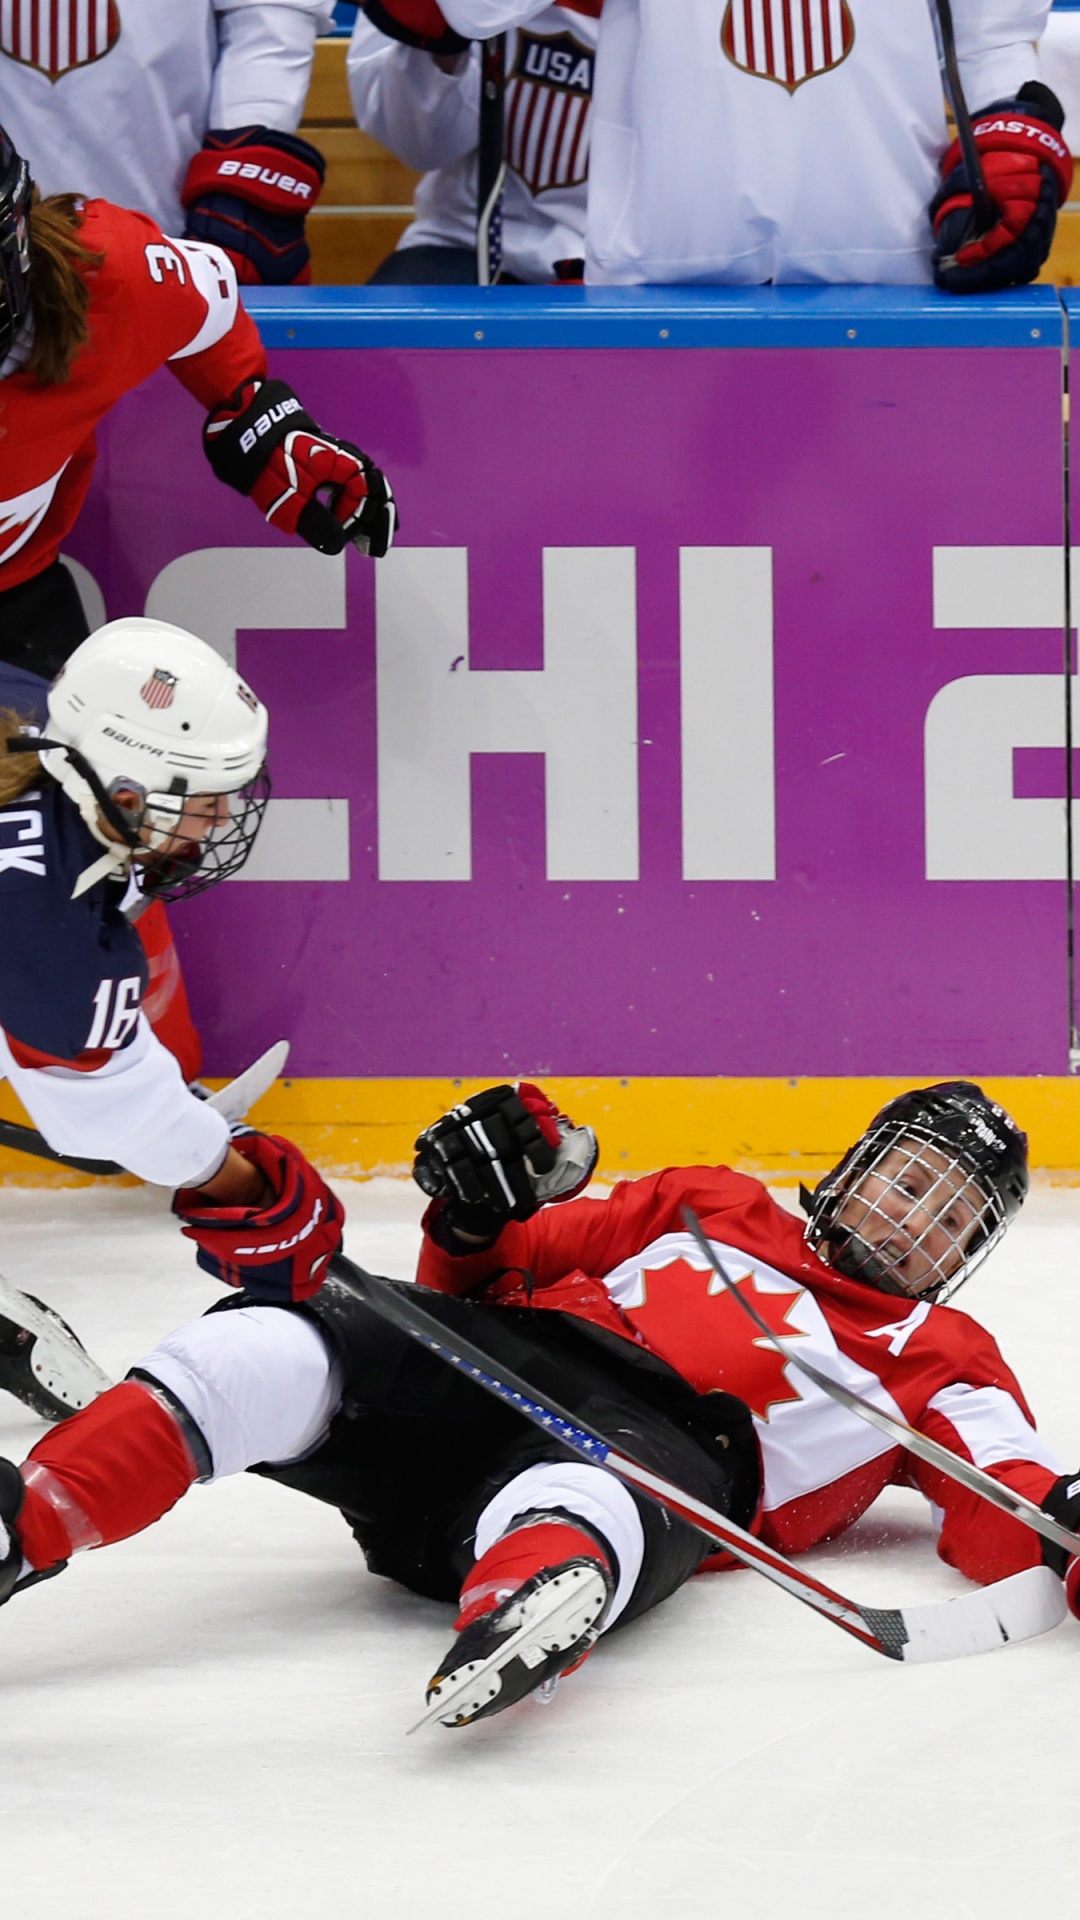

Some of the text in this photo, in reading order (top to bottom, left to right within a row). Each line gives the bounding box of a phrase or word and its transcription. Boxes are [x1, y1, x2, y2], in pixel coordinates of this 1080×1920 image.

[525, 44, 590, 89] USA
[973, 120, 1066, 157] EASTON
[217, 160, 312, 199] BAUER
[144, 243, 186, 286] 3
[239, 397, 304, 454] BAUER
[60, 546, 775, 881] CHI
[0, 791, 46, 876] CK
[84, 976, 142, 1050] 16
[863, 1300, 933, 1357] A
